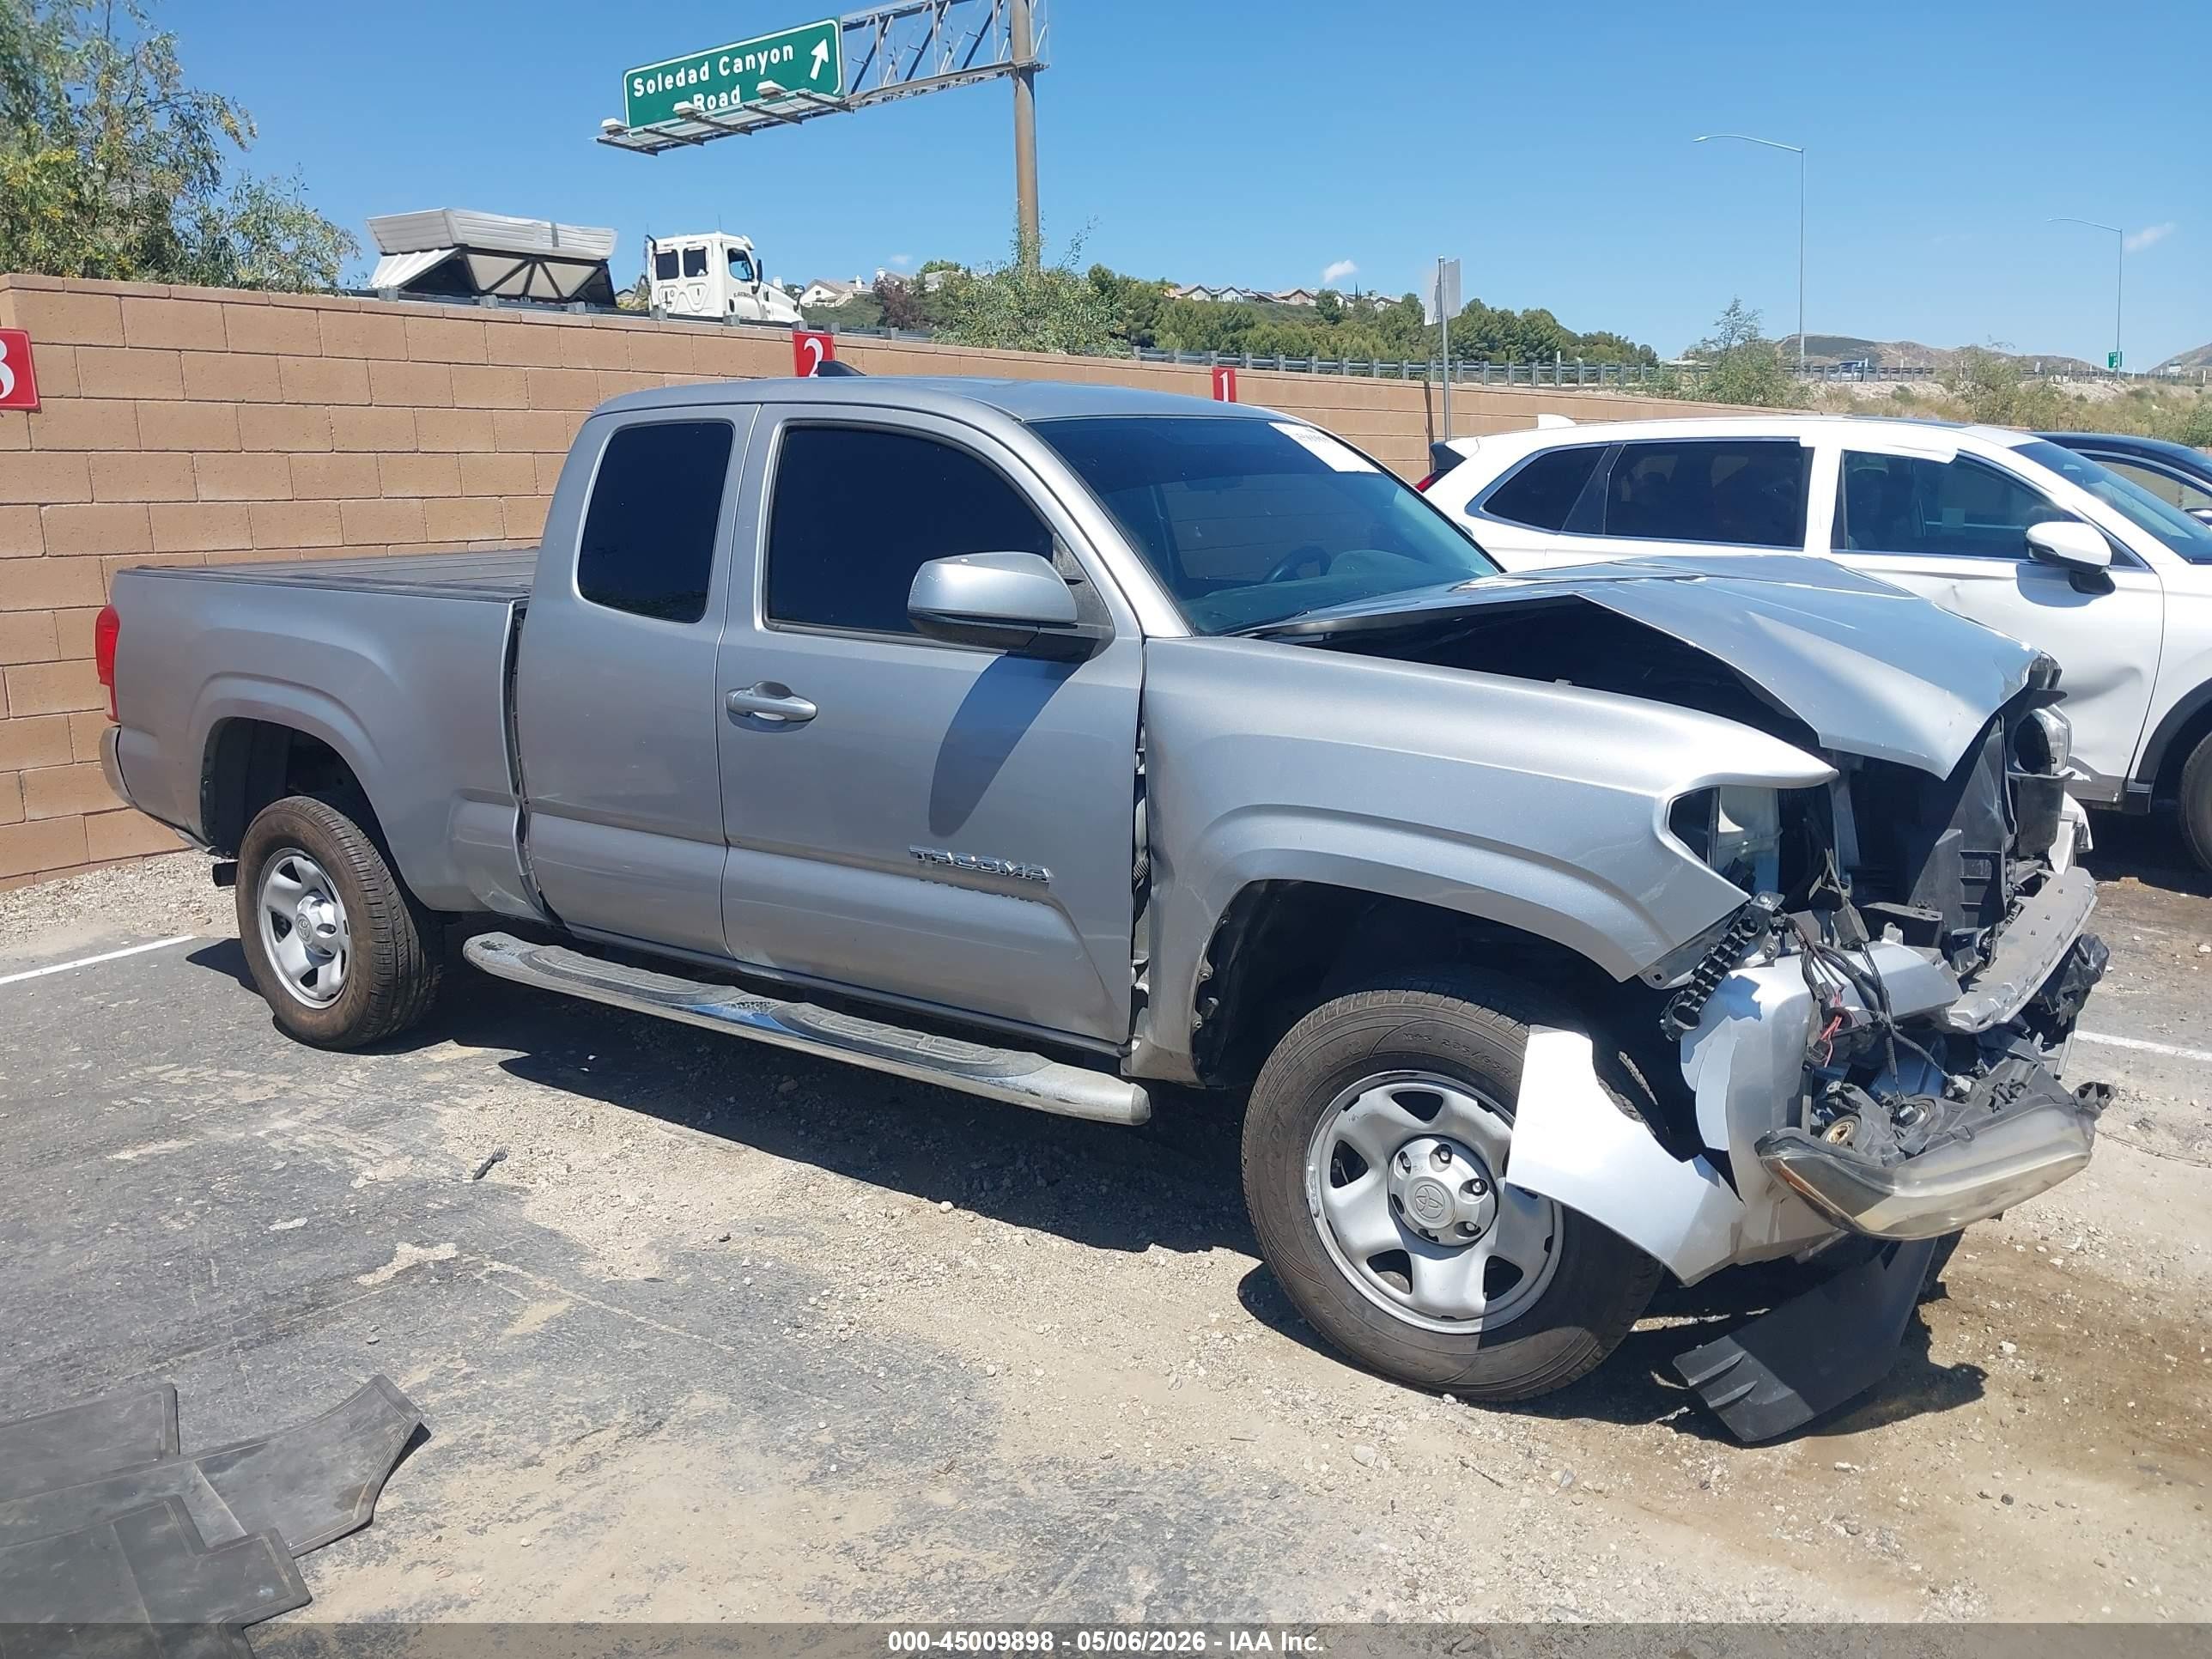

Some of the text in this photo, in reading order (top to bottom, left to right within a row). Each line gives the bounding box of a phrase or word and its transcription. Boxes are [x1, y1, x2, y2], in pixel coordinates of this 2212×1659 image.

[633, 44, 794, 97] Soledad Canyon
[692, 84, 742, 112] Road
[803, 337, 823, 378] 2
[1218, 370, 1230, 403] 1
[908, 844, 1052, 884] TACOMA
